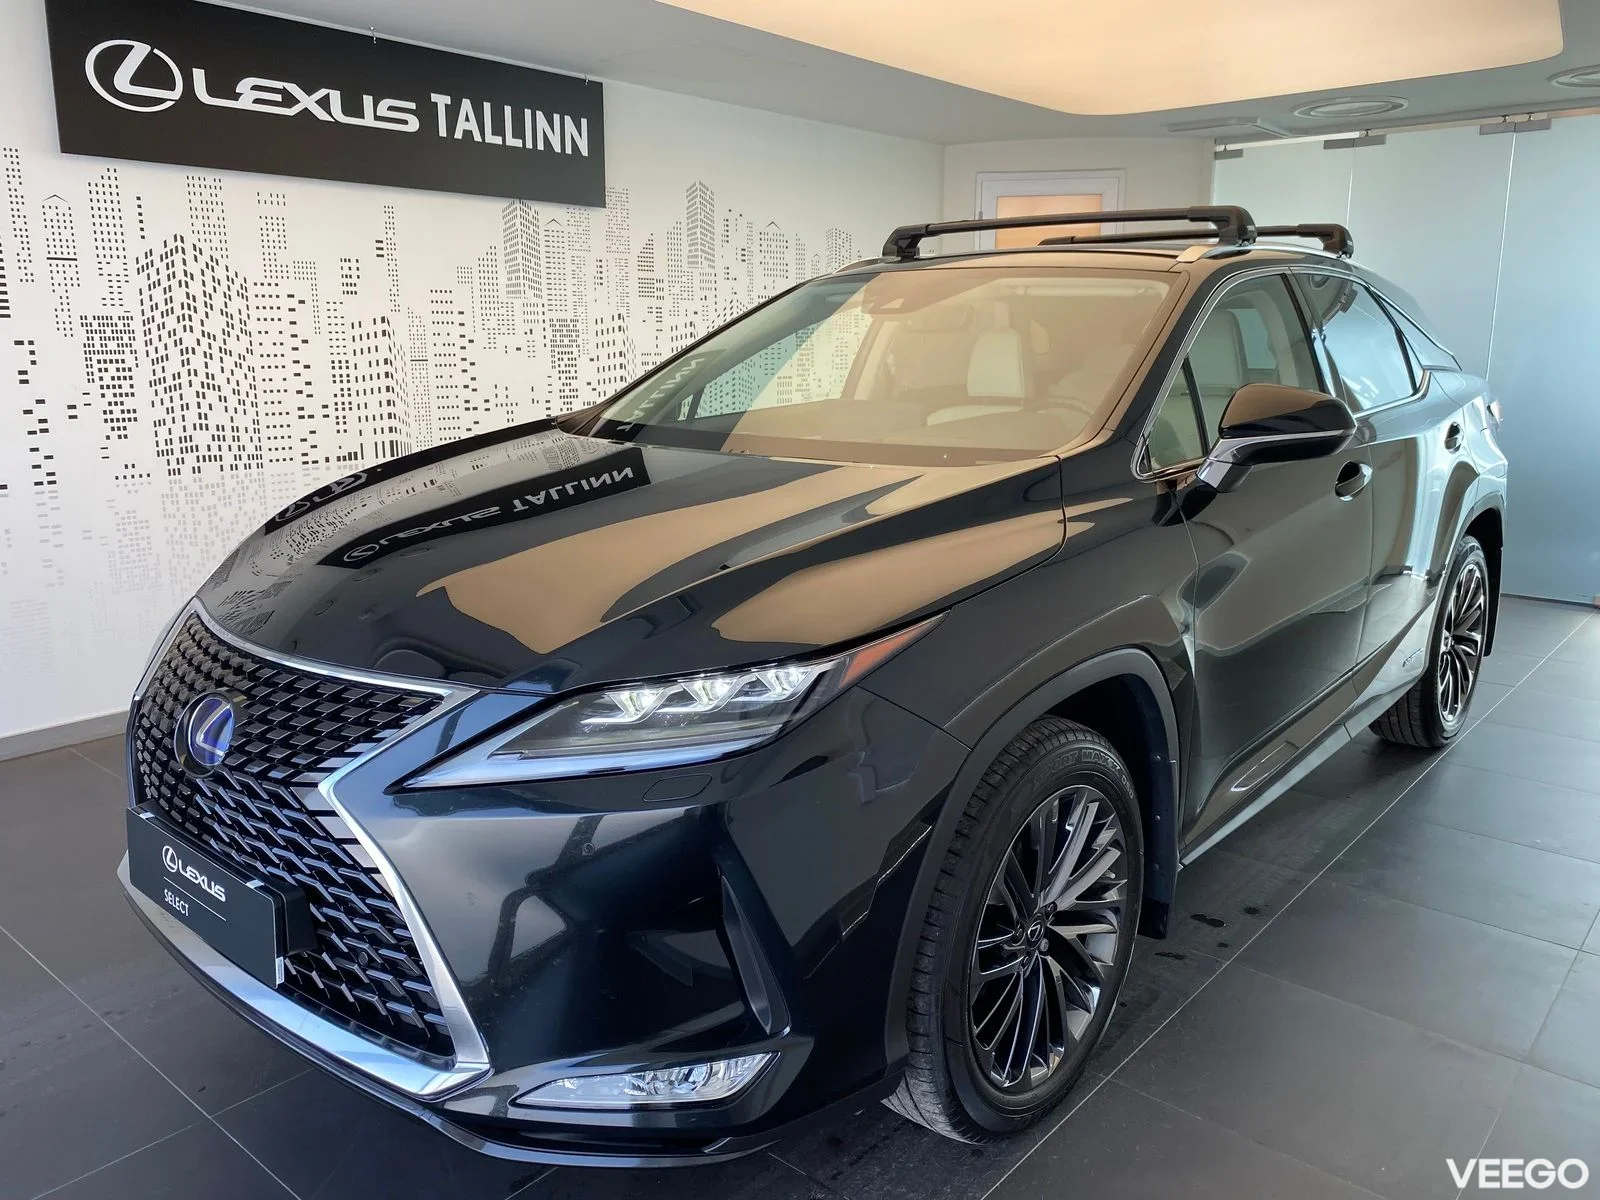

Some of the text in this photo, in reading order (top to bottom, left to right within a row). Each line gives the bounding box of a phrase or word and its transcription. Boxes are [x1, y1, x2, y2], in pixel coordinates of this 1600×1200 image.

[192, 67, 420, 133] LEXUS
[430, 93, 589, 157] TALLINN
[163, 888, 189, 917] SELECT
[178, 859, 226, 903] LEXUS
